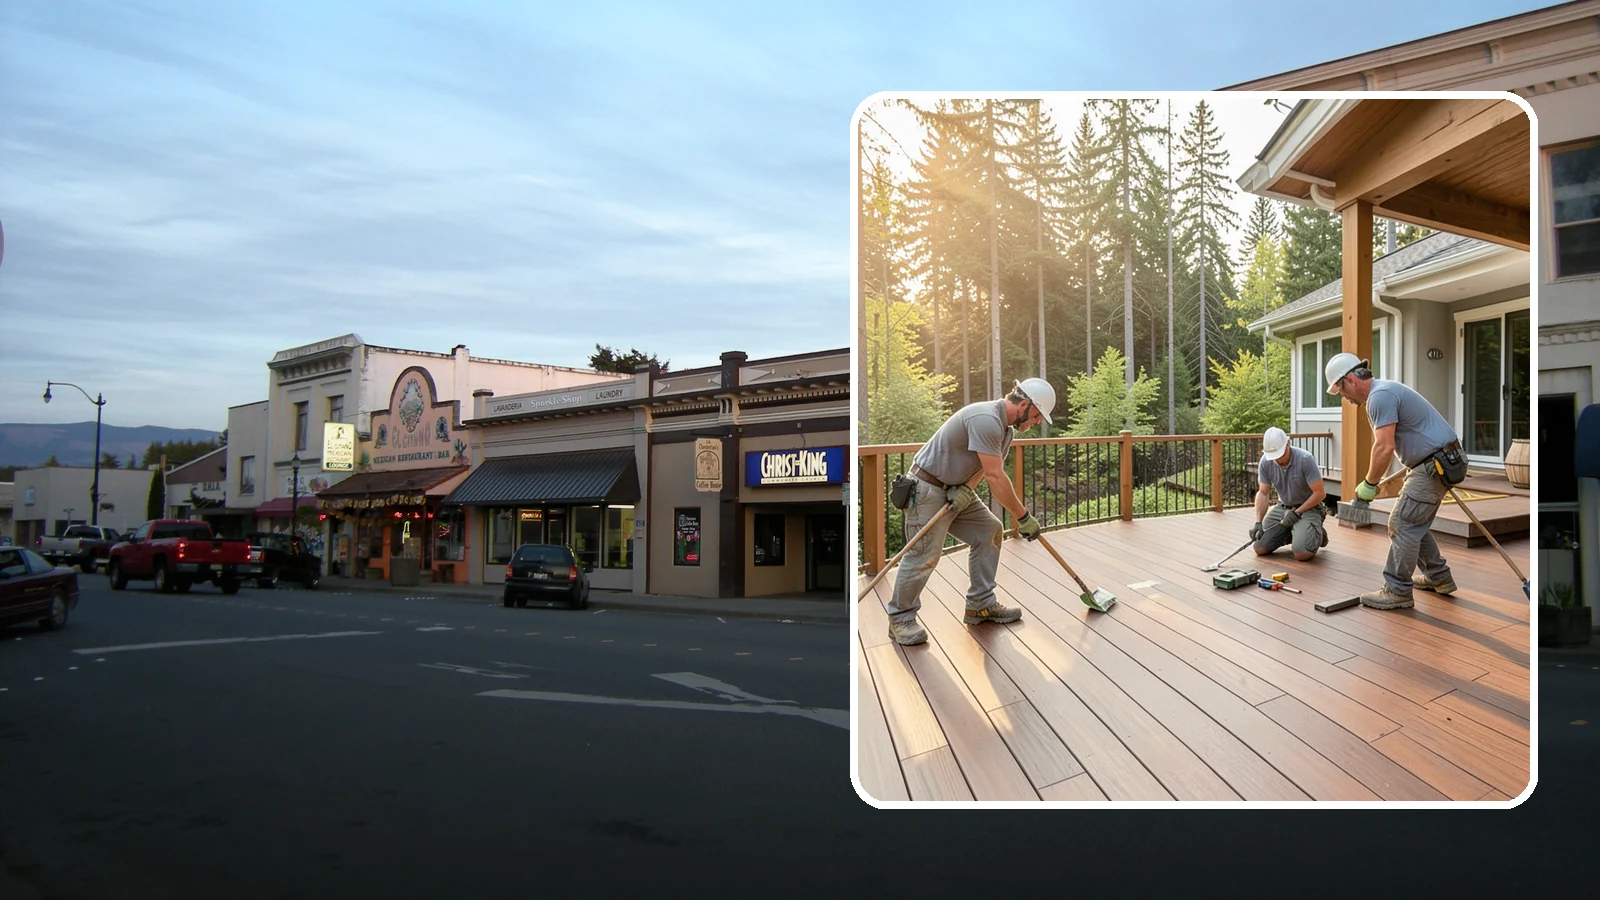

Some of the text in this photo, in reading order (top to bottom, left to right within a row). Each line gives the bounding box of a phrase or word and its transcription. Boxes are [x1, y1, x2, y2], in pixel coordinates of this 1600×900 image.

[531, 394, 582, 409] Sparkle Shop
[595, 389, 623, 400] LAUNDRY
[494, 402, 523, 412] LAVANDERIA
[374, 455, 396, 464] MEXICAN
[397, 451, 433, 462] RESTAURANT
[438, 450, 450, 459] BAR
[760, 450, 827, 478] CHRIST KING
